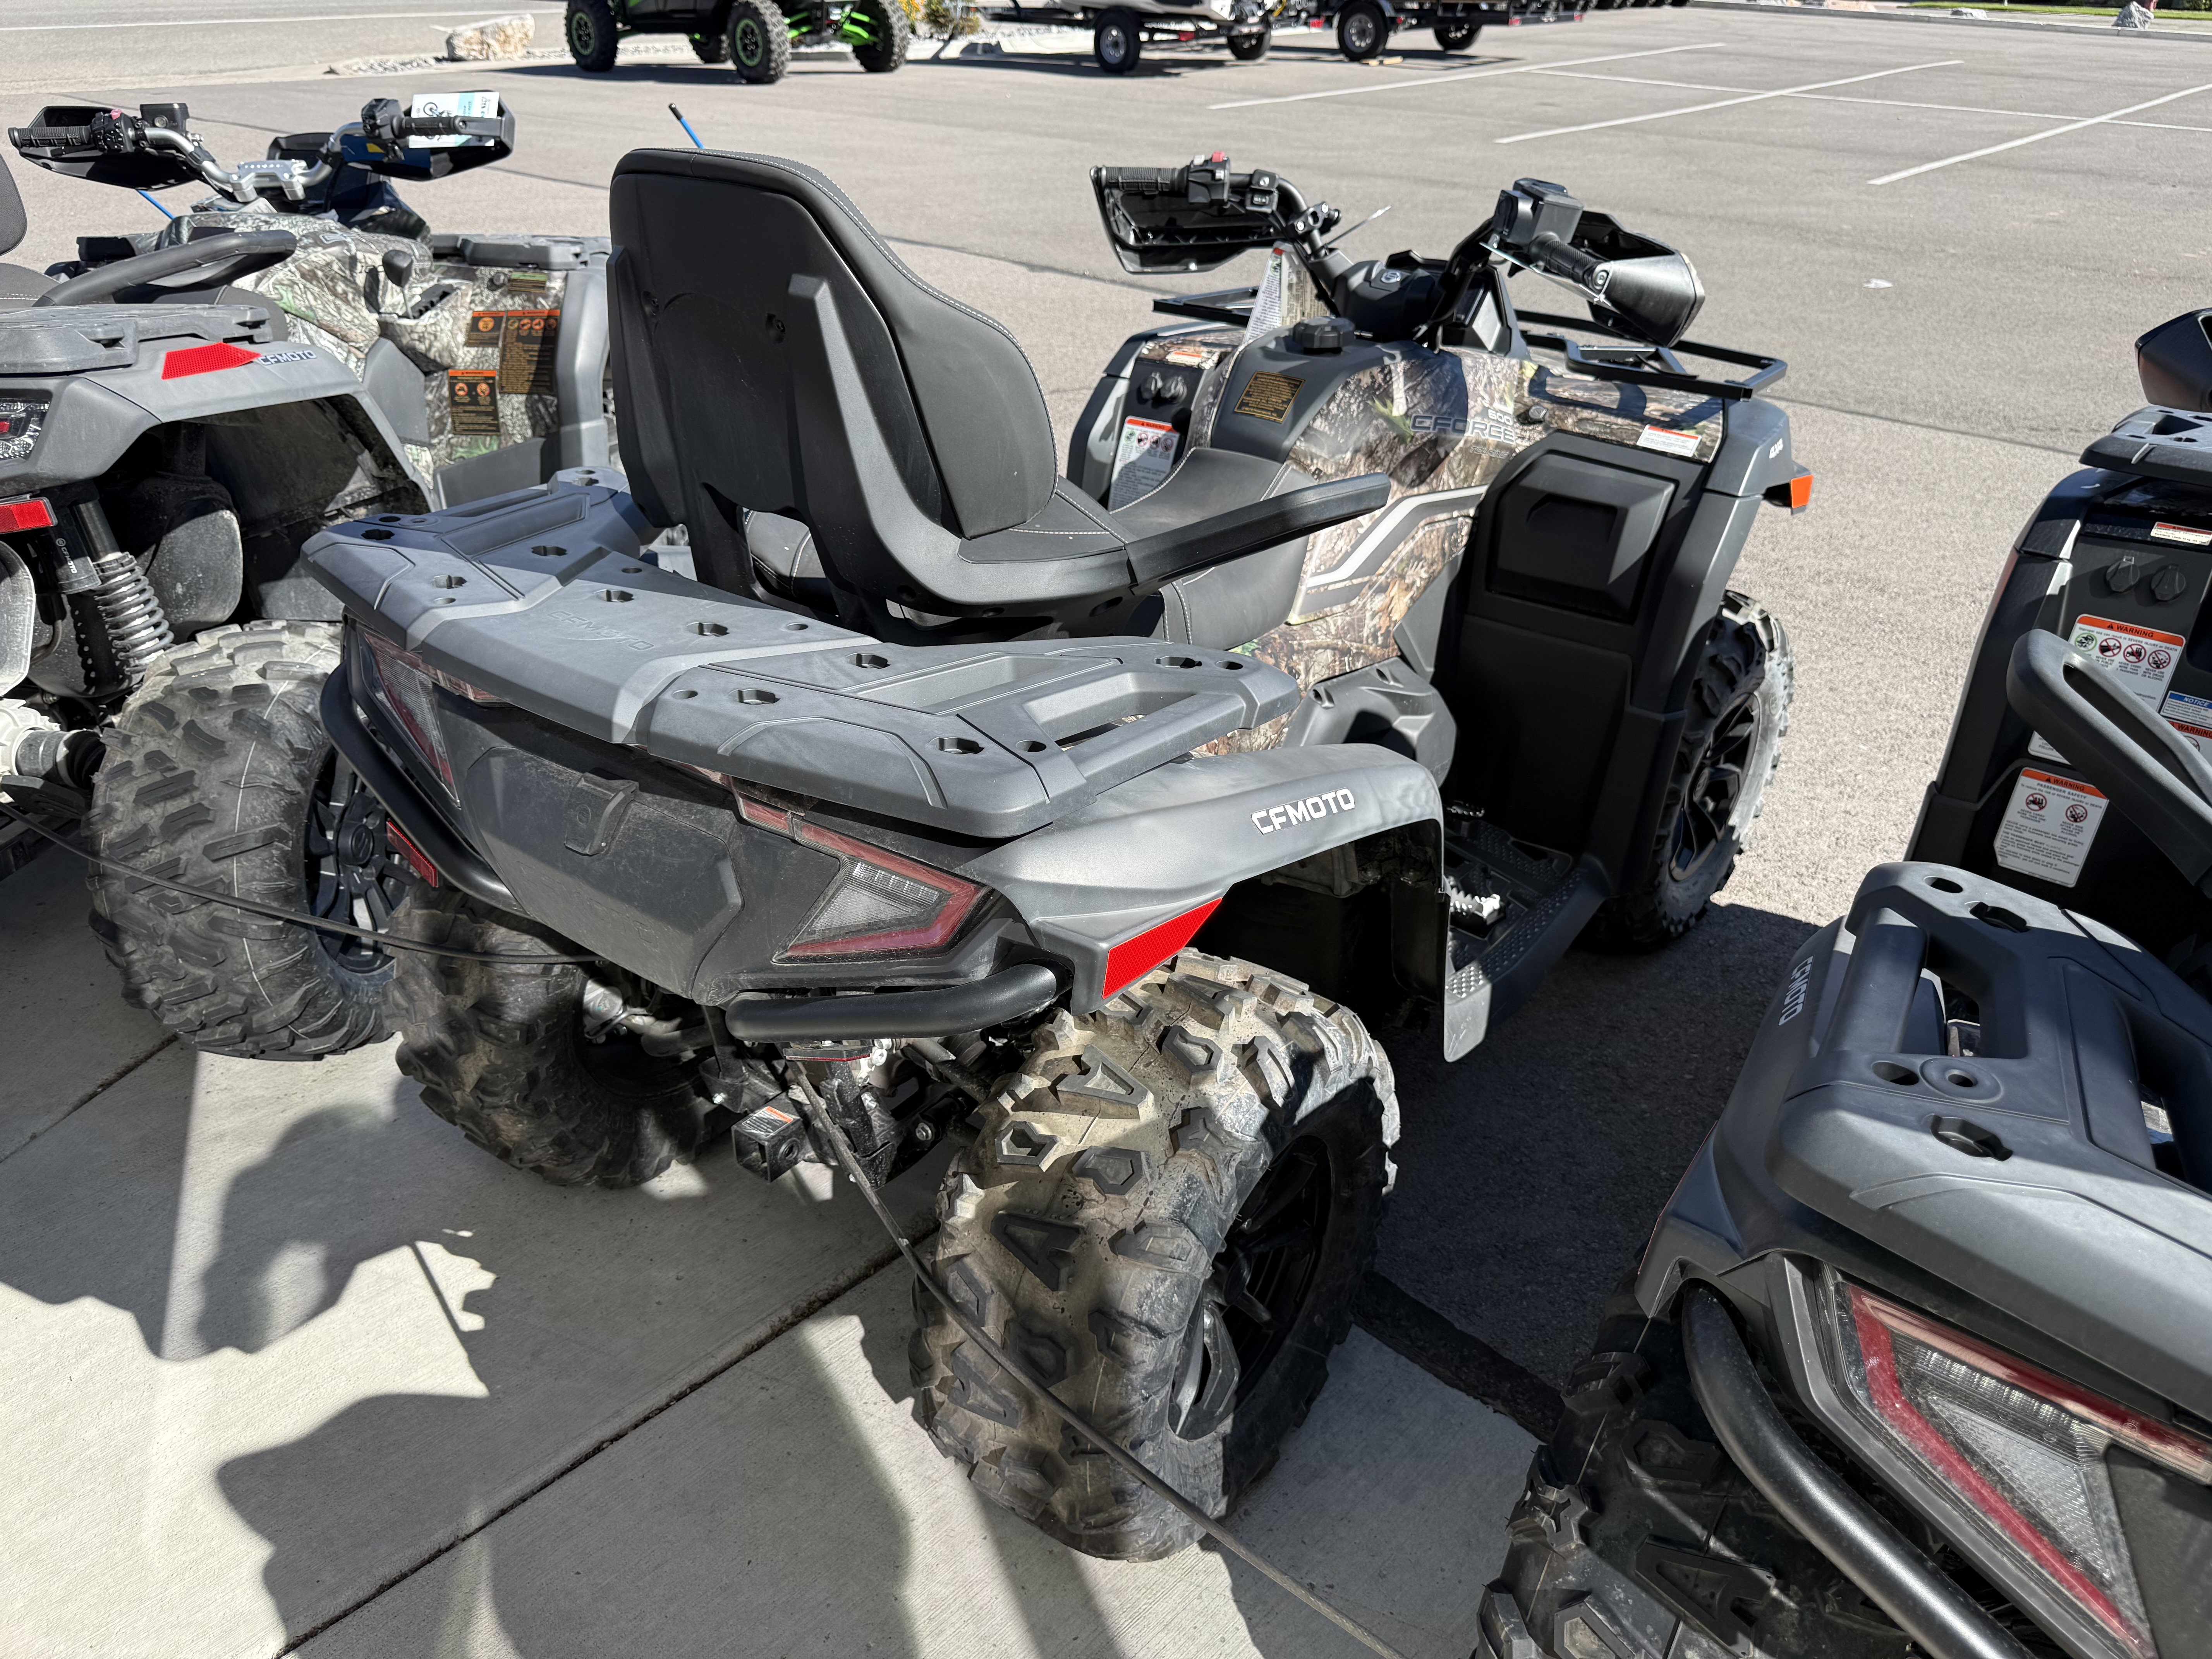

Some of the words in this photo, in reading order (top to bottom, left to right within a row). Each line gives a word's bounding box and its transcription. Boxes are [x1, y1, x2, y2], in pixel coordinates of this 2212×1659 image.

[258, 350, 317, 365] CFMOTO
[1488, 409, 1513, 426] 600
[1411, 414, 1515, 444] CFORCE
[61, 547, 77, 574] CFMOTO
[548, 611, 654, 651] CFMOTO
[2116, 624, 2154, 638] WARNING
[2183, 697, 2209, 707] NOTICE
[2037, 783, 2066, 793] PASSENGER
[2068, 790, 2087, 799] SAFETY
[2053, 778, 2085, 791] WARNING
[1252, 788, 1355, 835] CFMOTO
[1779, 956, 1814, 1025] CFMOTO
